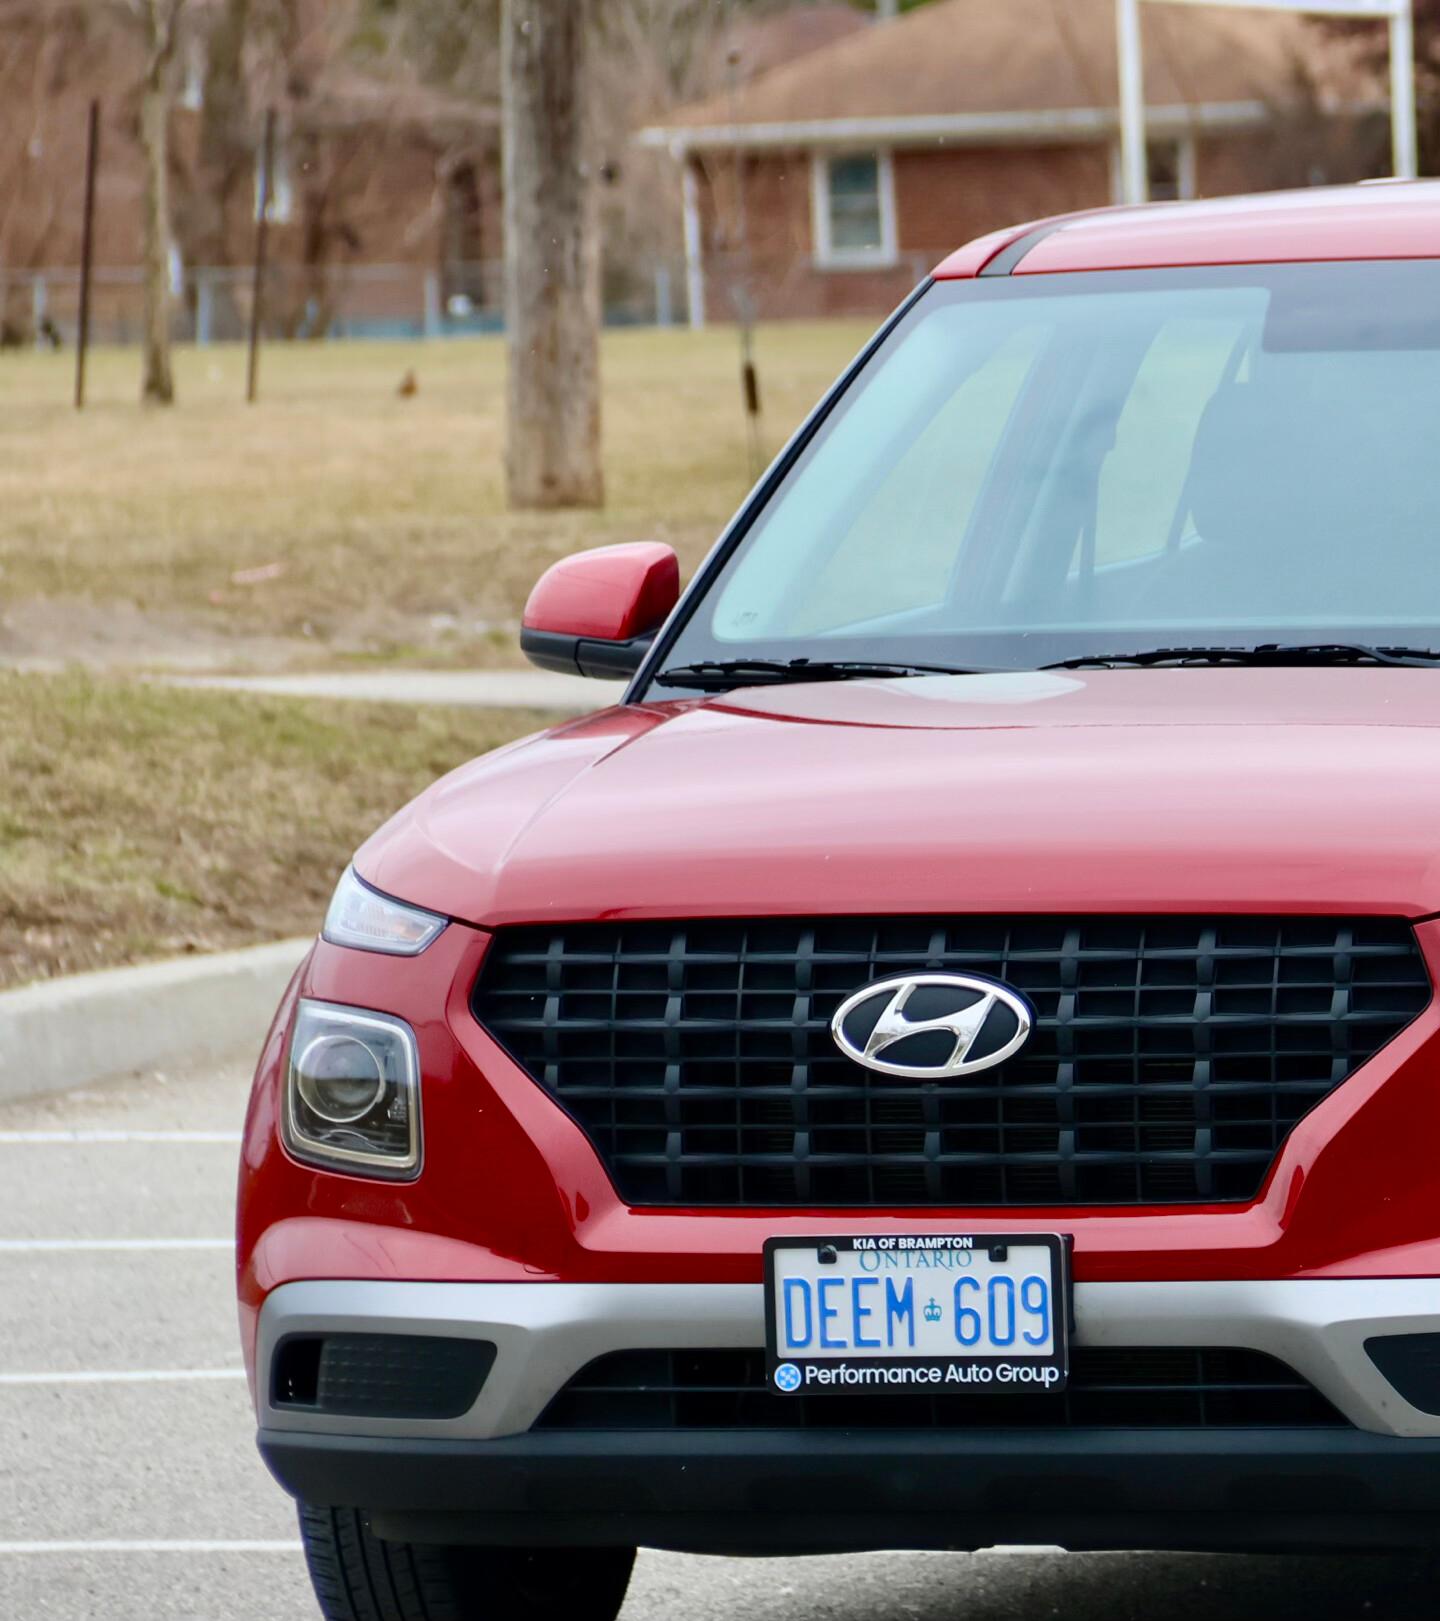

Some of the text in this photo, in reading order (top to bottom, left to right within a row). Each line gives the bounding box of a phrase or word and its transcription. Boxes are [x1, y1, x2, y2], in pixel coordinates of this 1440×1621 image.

[853, 1237, 973, 1250] KIA OF BRAMPTON
[859, 1250, 973, 1271] ONTARIO
[783, 1275, 1049, 1348] DEEM 609
[805, 1363, 1059, 1388] Performance Auto Group
